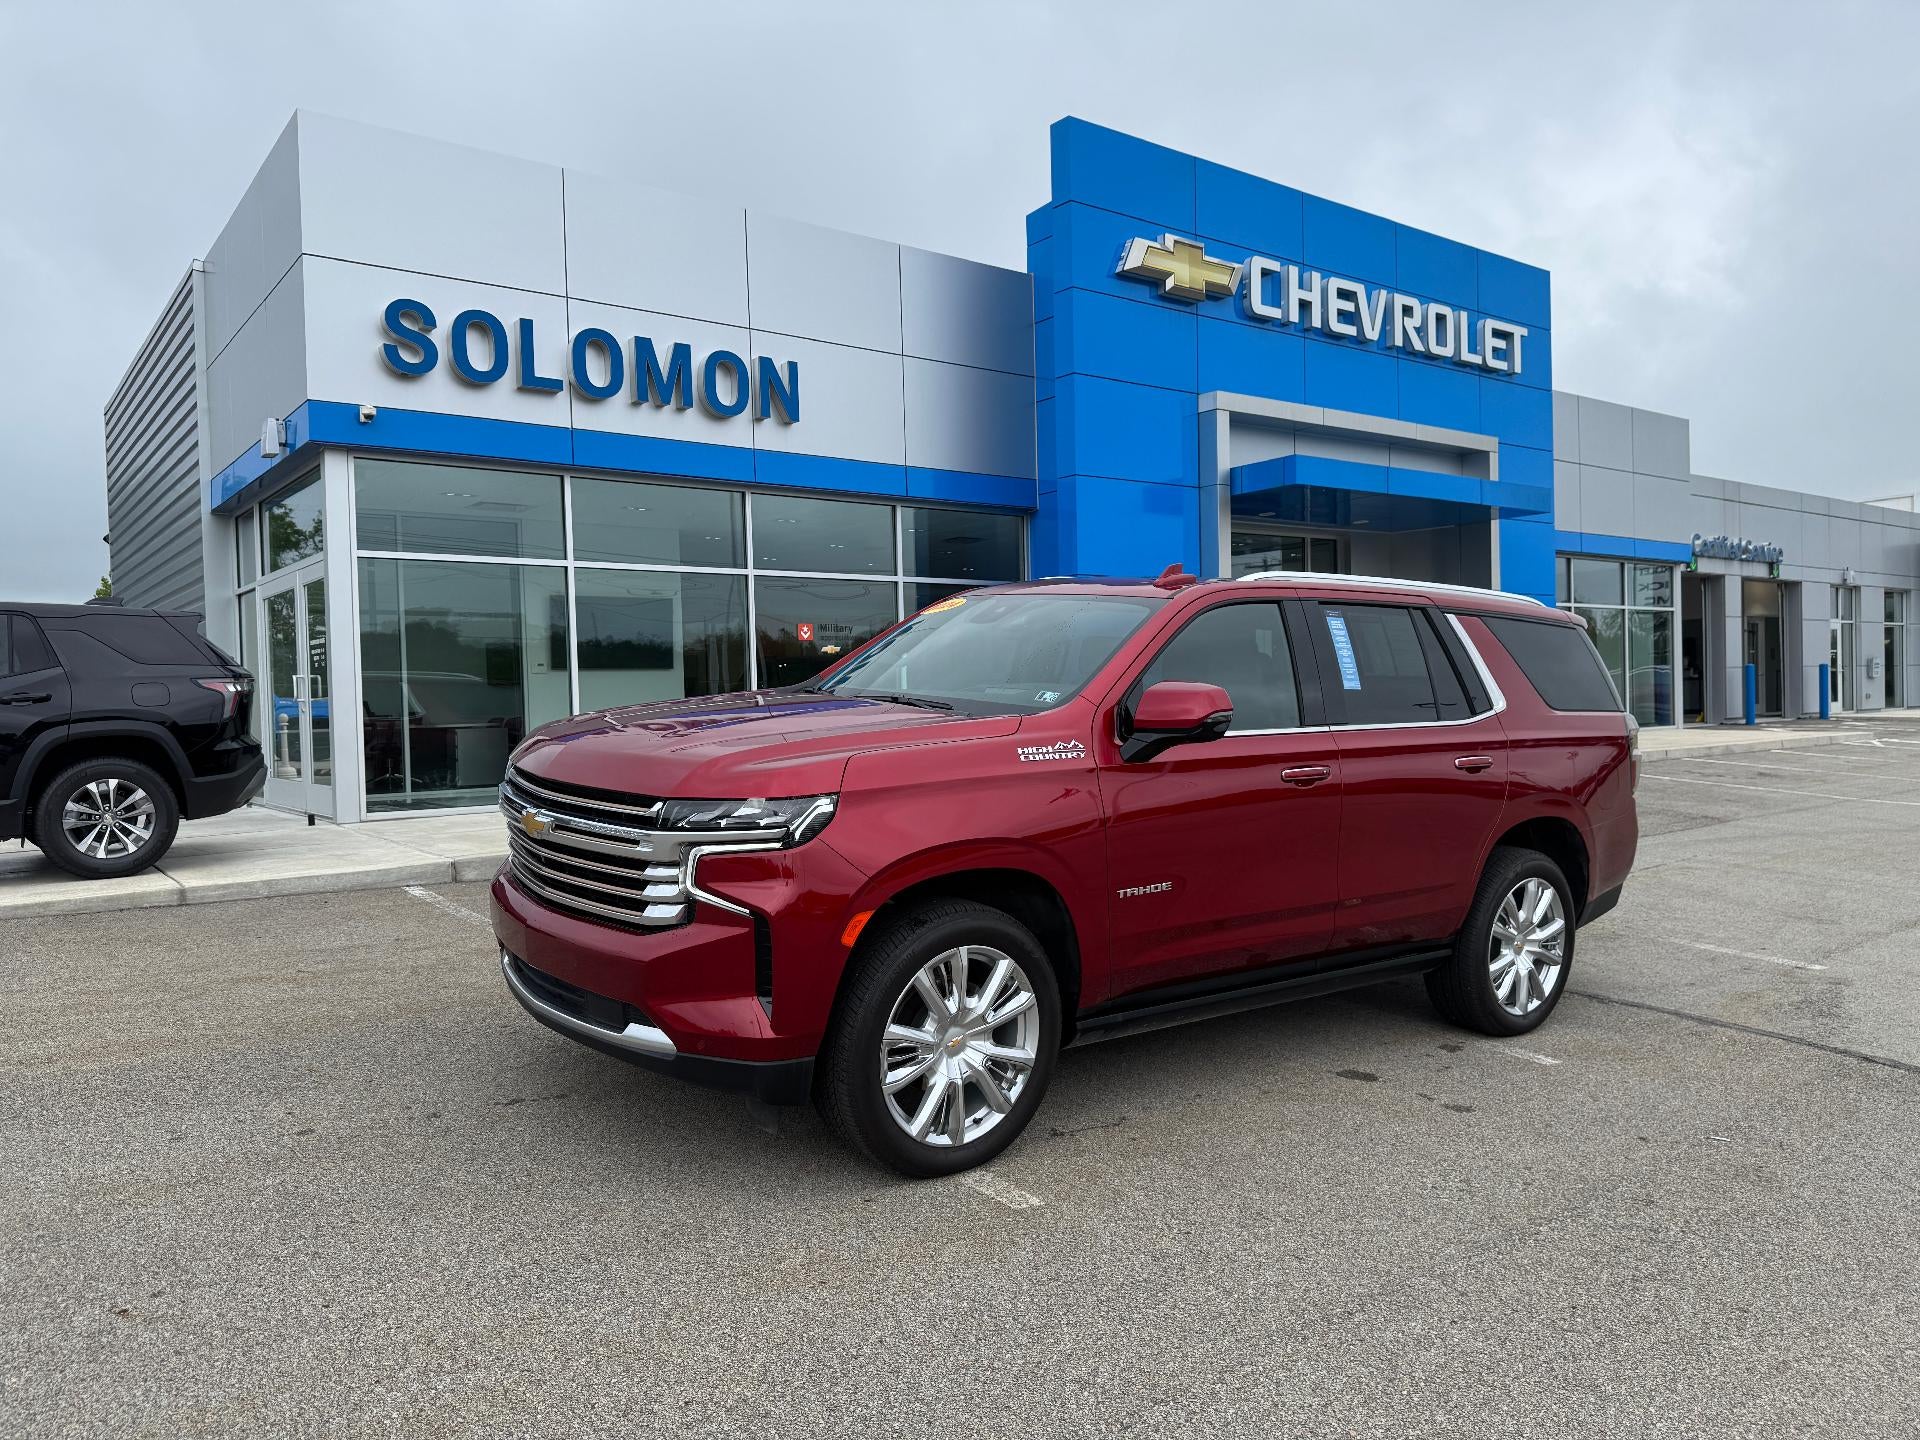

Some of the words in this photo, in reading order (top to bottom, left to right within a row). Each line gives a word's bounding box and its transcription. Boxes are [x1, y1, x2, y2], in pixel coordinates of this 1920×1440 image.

[1242, 254, 1529, 376] CHEVROLET
[378, 298, 801, 426] SOLOMON
[1691, 533, 1742, 559] Certified
[1738, 541, 1784, 563] Service
[820, 623, 853, 634] Military
[1017, 746, 1053, 754] HIGH
[1020, 751, 1086, 762] COUNTRY
[1116, 881, 1173, 899] TAHOE
